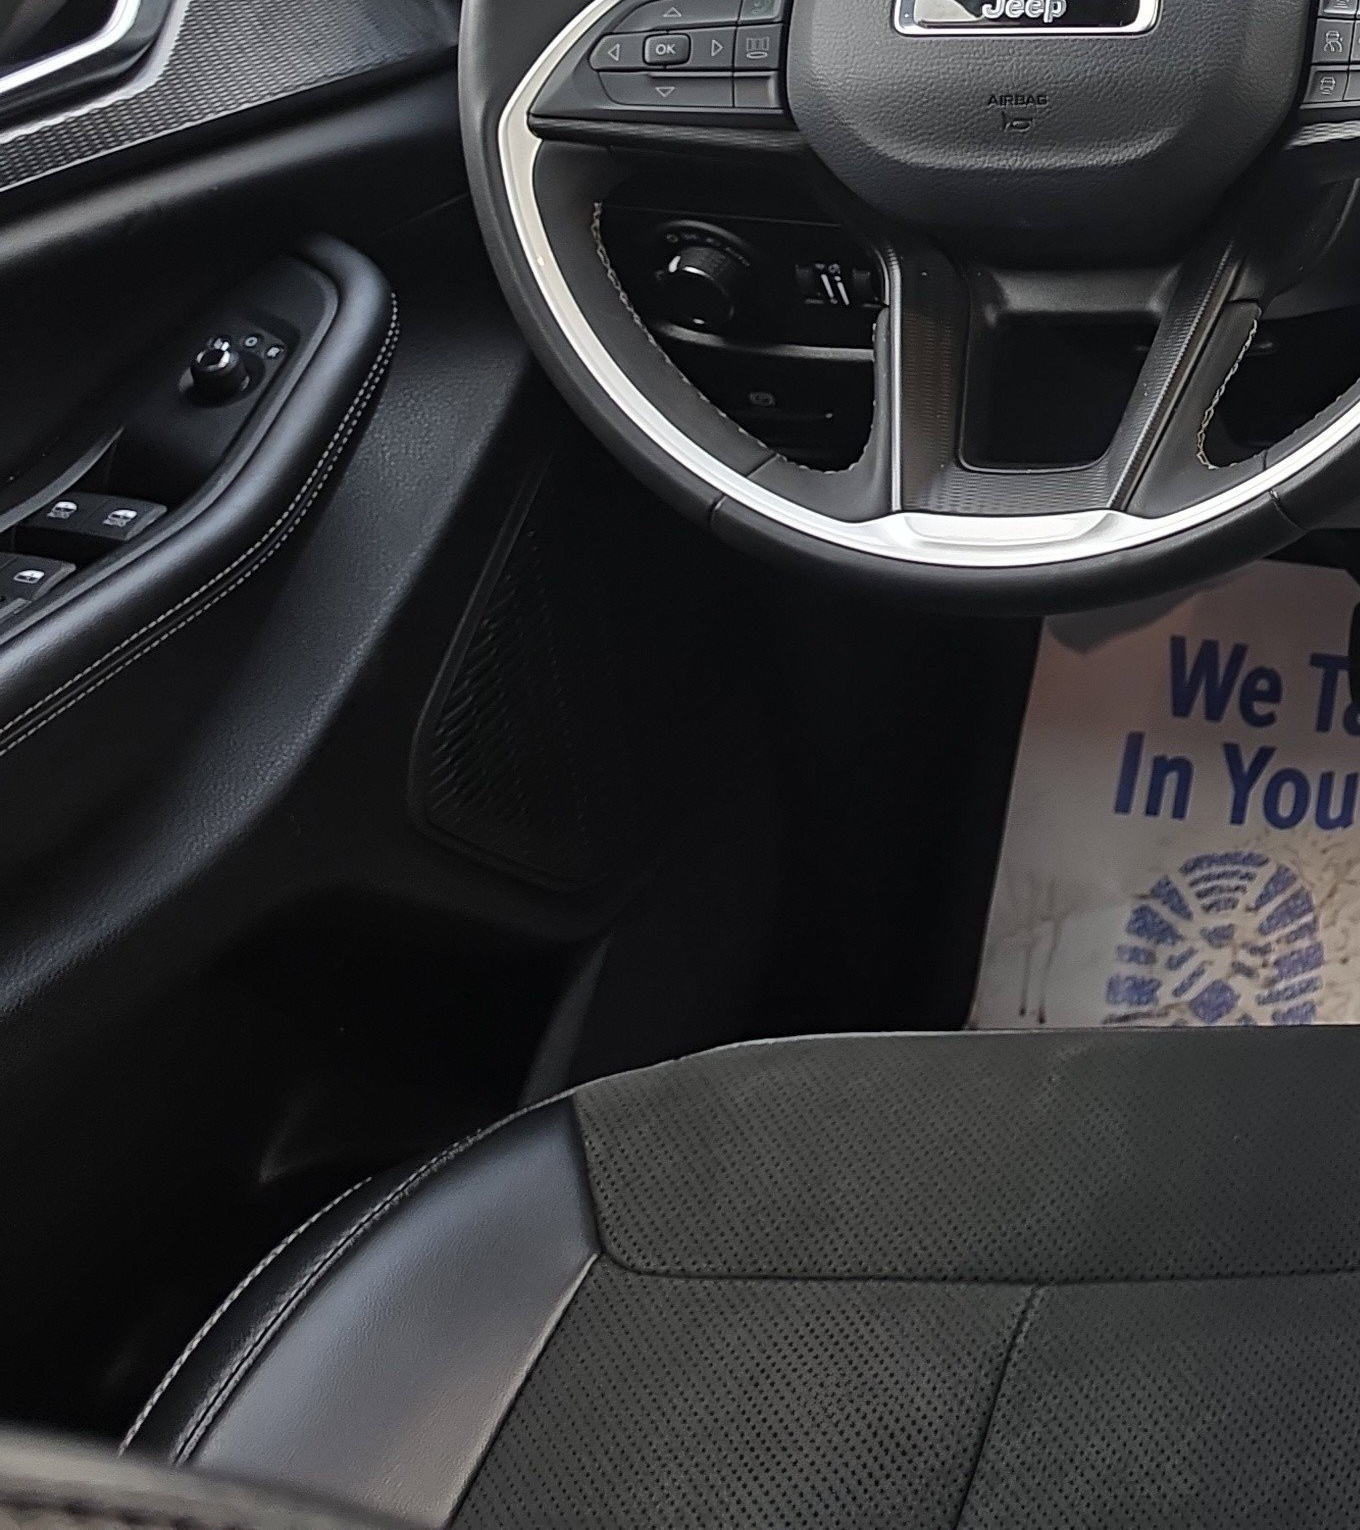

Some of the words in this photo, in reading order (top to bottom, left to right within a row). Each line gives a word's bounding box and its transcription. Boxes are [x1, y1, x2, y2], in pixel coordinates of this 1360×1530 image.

[655, 43, 676, 56] OK
[987, 94, 1048, 107] AIRBAG
[1169, 634, 1283, 727] We
[1113, 730, 1194, 818] In
